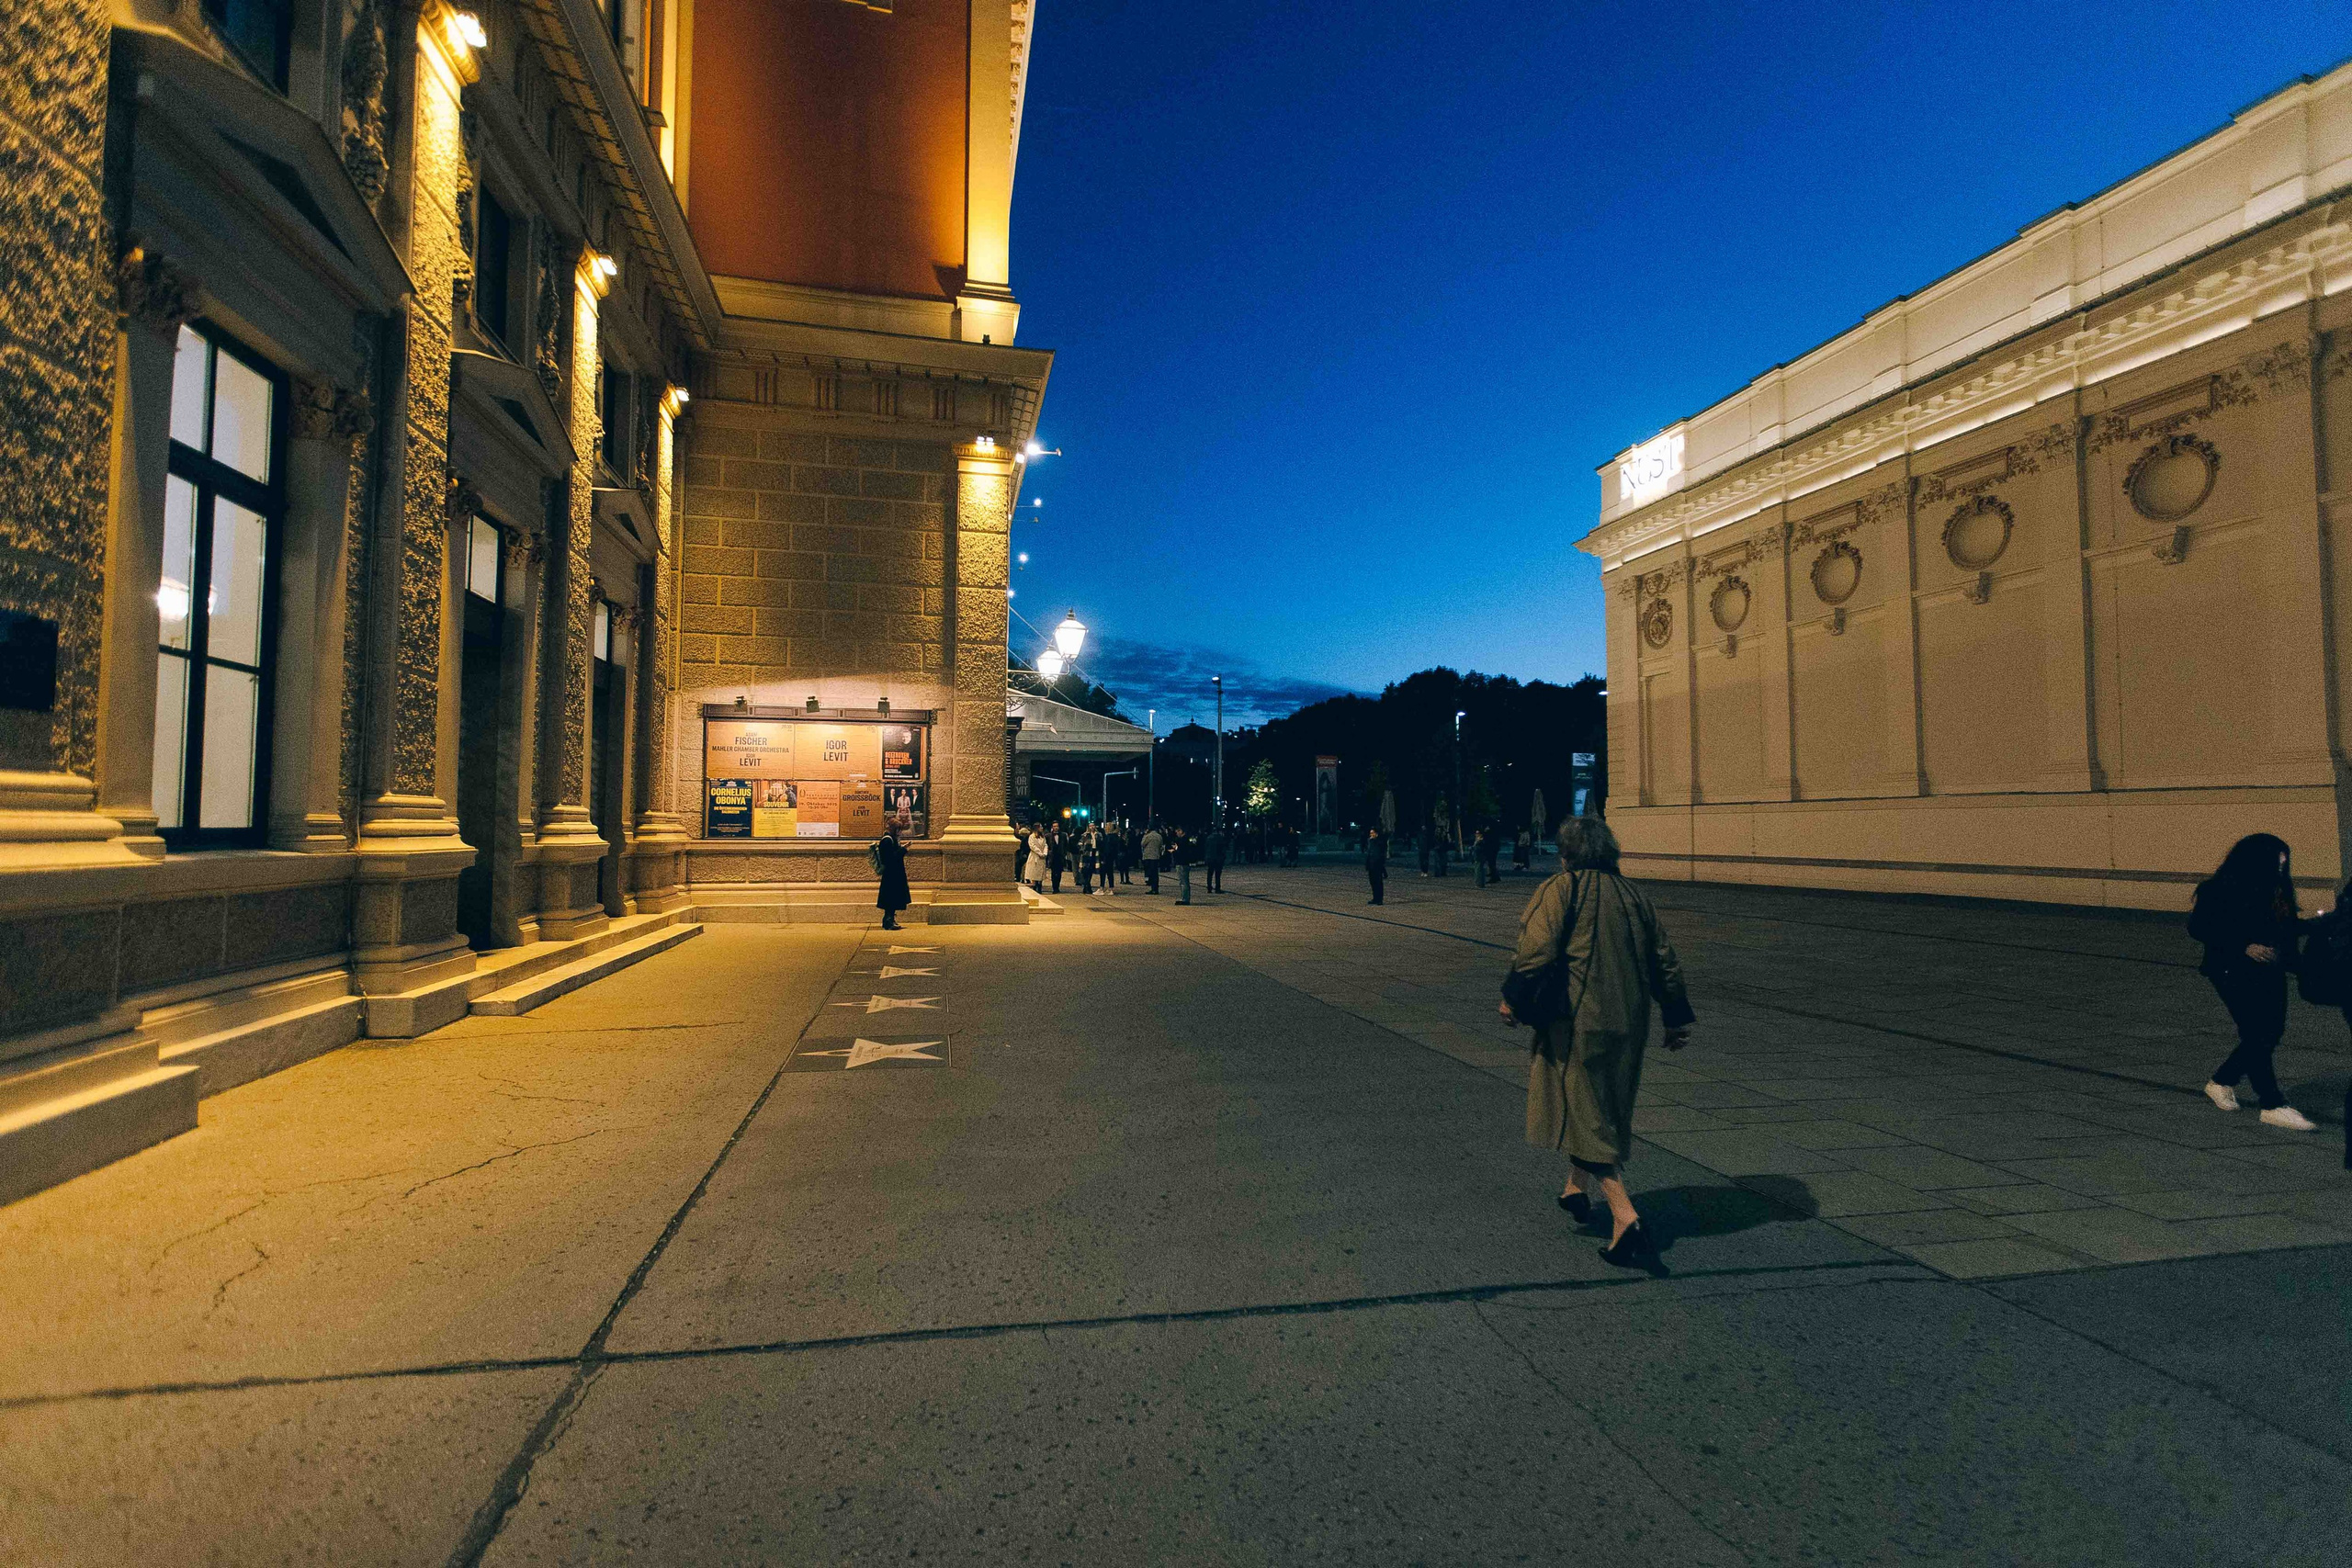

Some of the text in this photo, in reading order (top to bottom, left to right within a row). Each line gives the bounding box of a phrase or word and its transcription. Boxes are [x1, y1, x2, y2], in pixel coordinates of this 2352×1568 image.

[735, 737, 768, 746] FISCHER
[826, 739, 847, 750] IGOR
[823, 751, 849, 761] LEVIT
[740, 758, 762, 766] LEVIT
[710, 787, 752, 796] CORNELIUS
[716, 796, 746, 805] OBONYA
[842, 794, 881, 802] GROISSBÖCK
